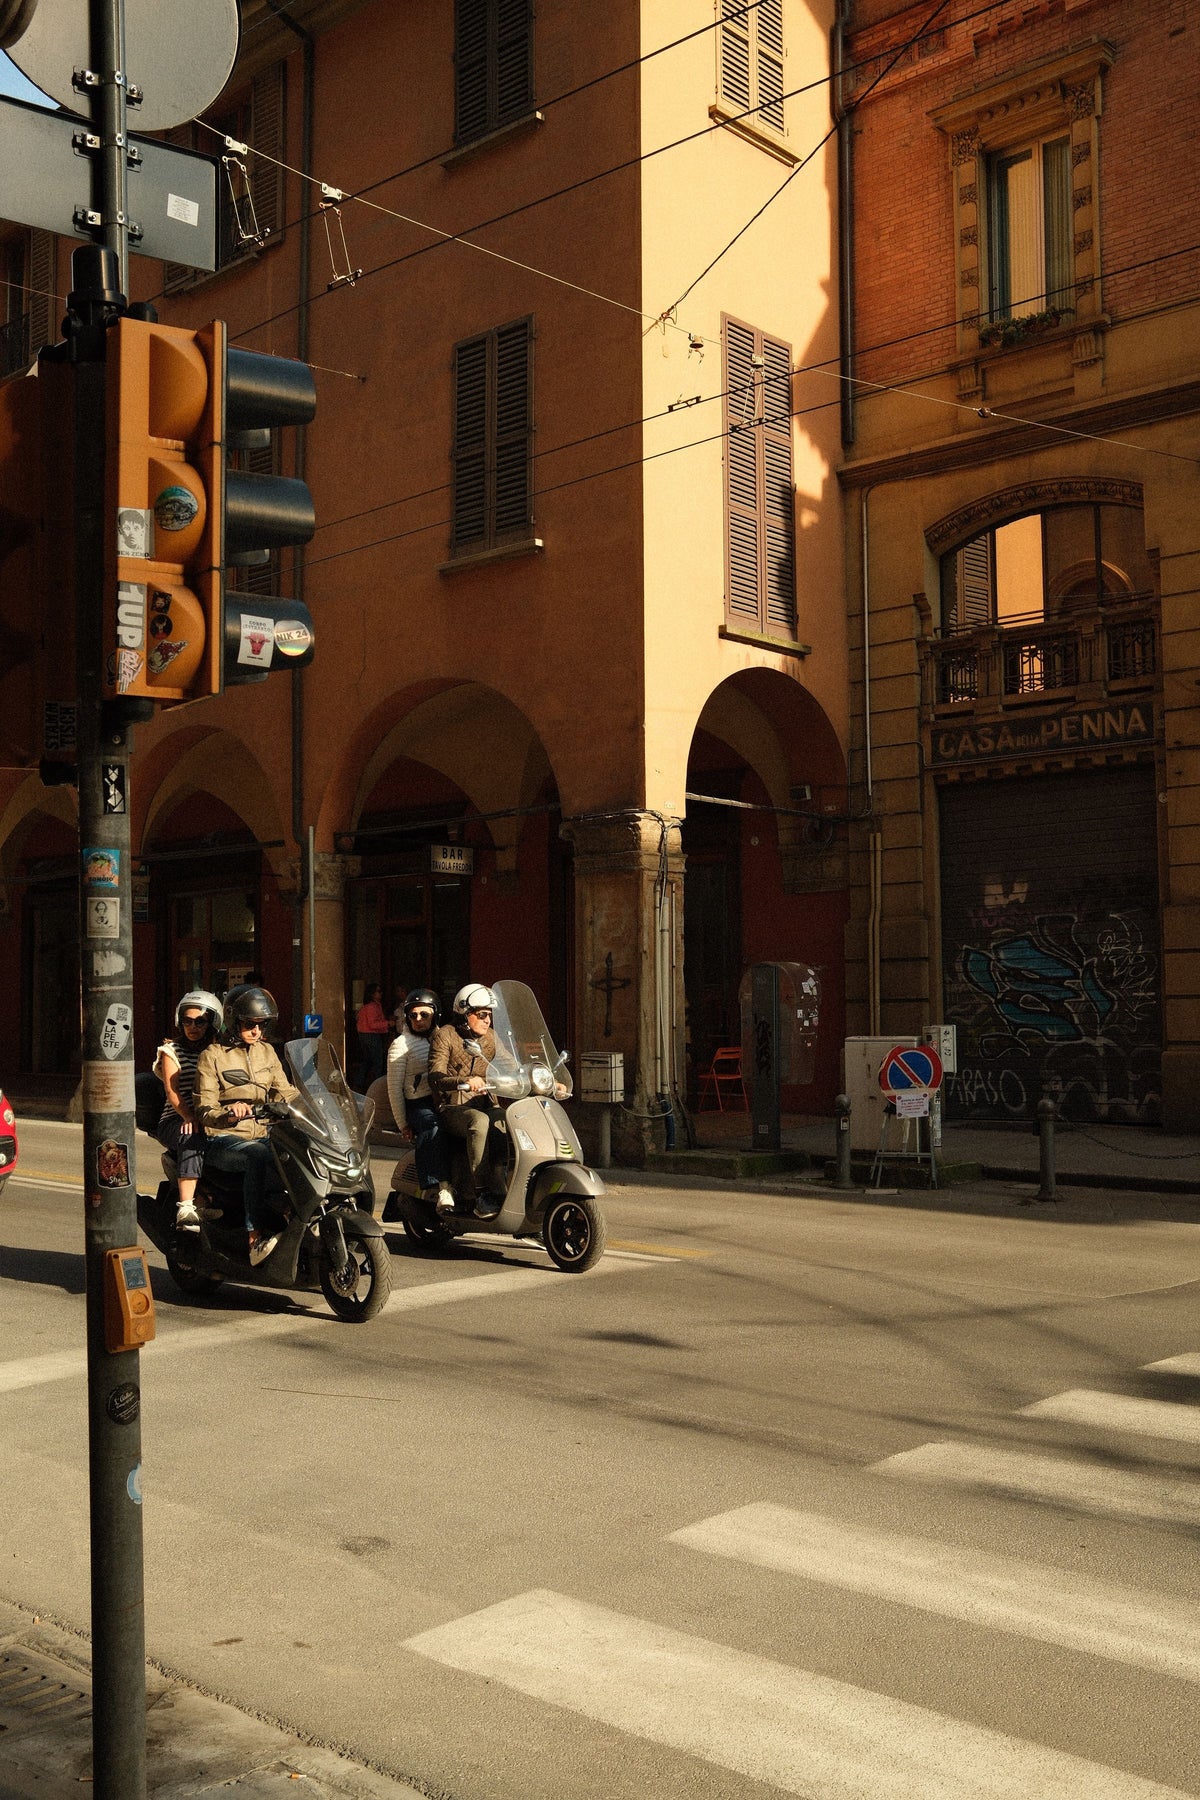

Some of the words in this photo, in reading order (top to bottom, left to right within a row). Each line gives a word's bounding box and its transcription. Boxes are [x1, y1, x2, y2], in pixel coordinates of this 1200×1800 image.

[117, 584, 144, 648] 1UP
[276, 632, 294, 642] NIK
[295, 629, 308, 639] 24
[938, 725, 1018, 759] CASA
[1040, 706, 1149, 743] PENNA
[442, 847, 463, 861] BAR
[431, 860, 452, 872] TAVOLA
[104, 1025, 117, 1033] LA
[103, 1033, 116, 1041] PE
[102, 1040, 120, 1049] STE
